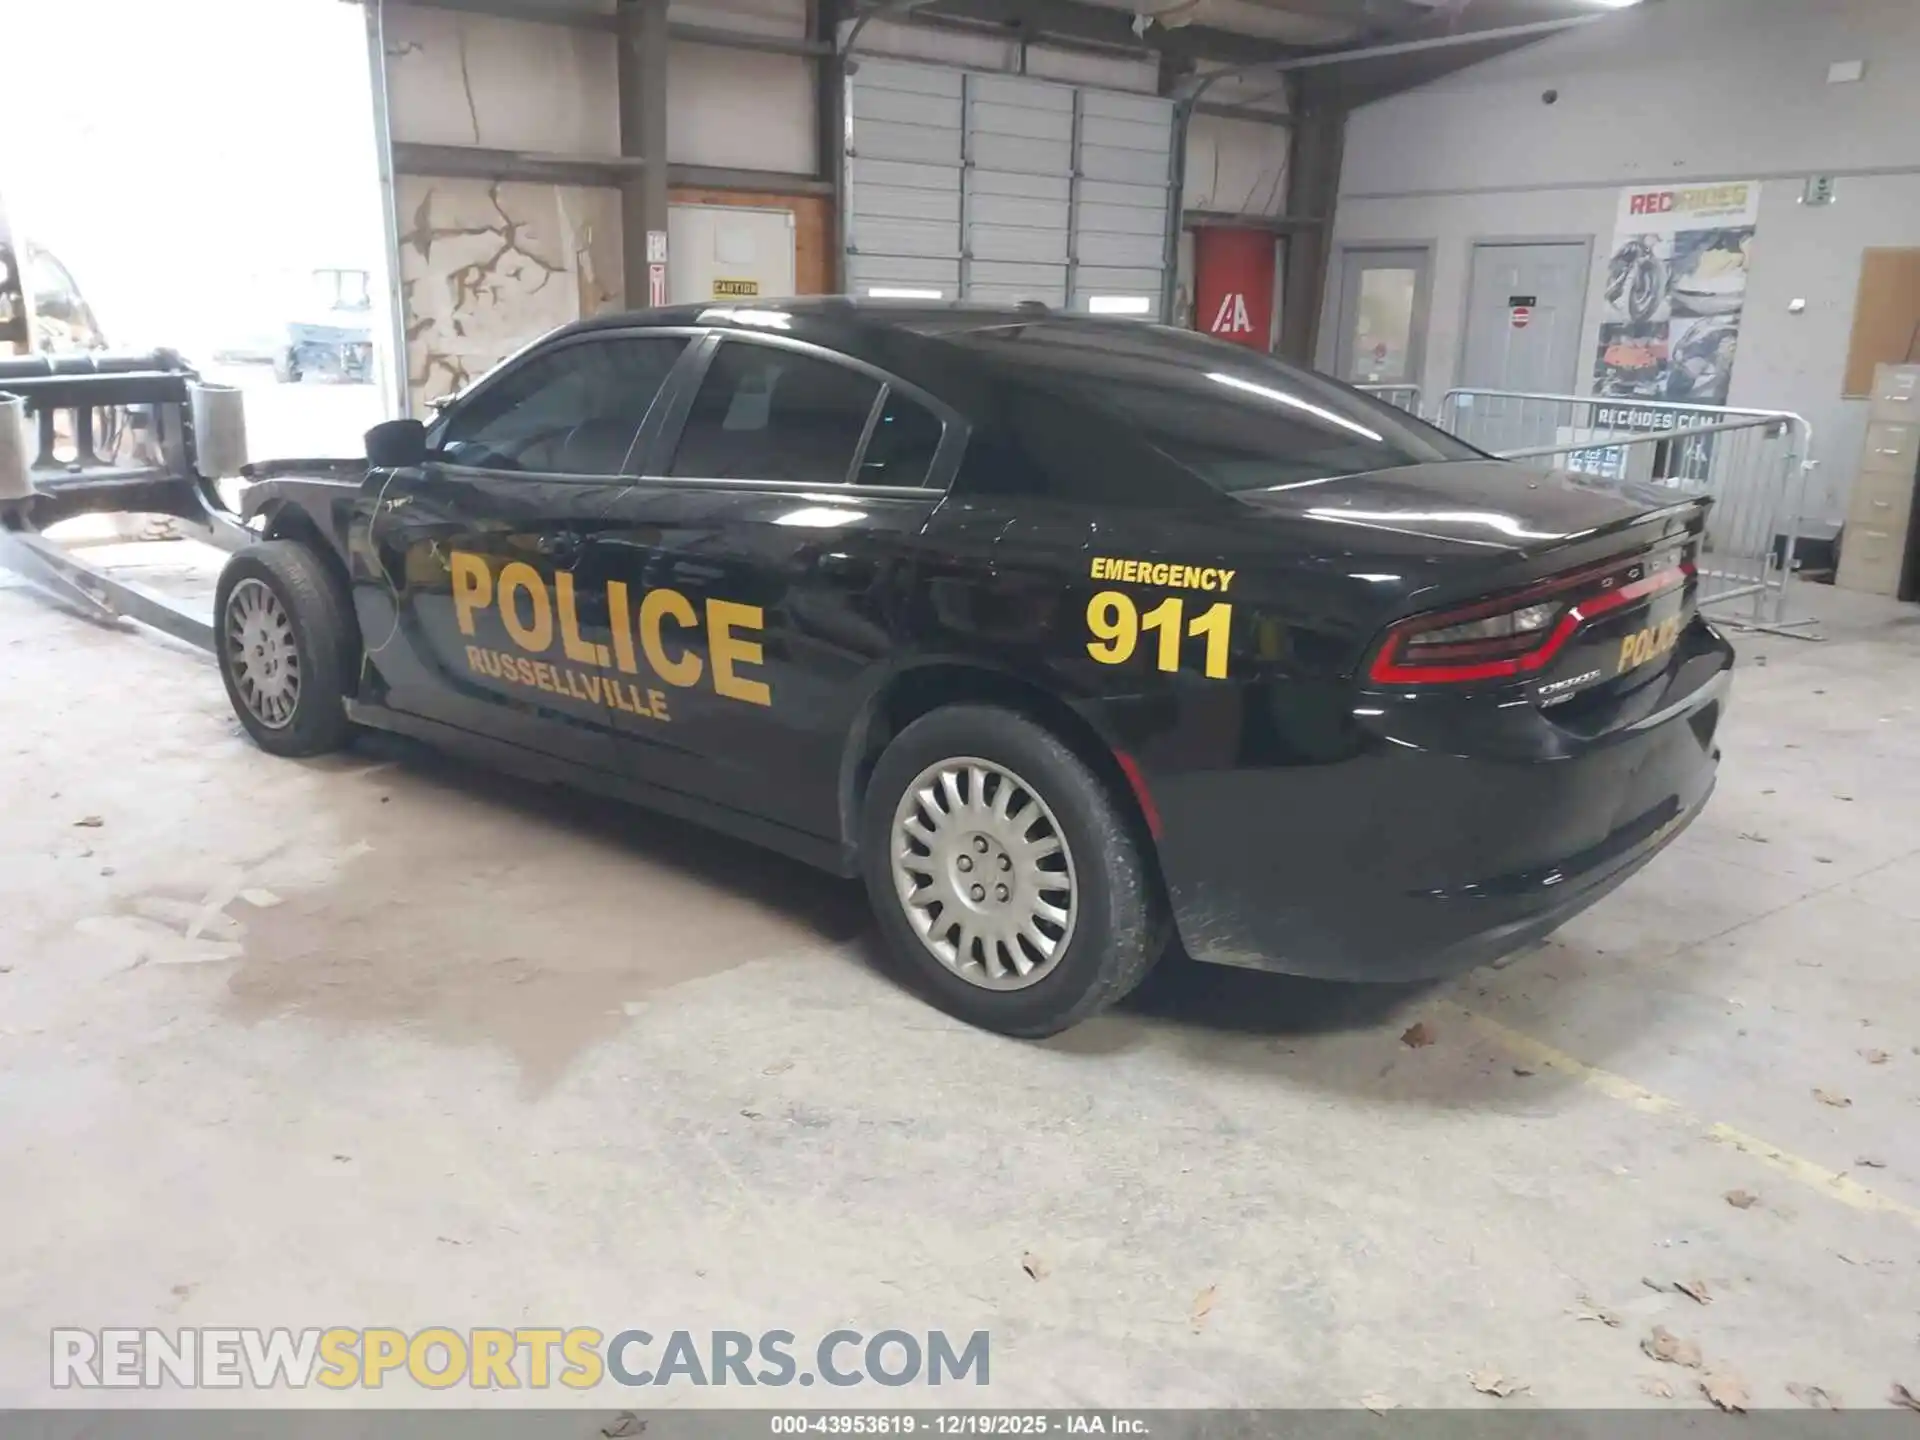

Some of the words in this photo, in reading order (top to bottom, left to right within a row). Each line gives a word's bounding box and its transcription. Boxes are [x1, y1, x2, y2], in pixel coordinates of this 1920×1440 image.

[1091, 557, 1236, 592] EMERGENCY
[451, 551, 772, 706] POLICE
[1086, 590, 1233, 680] 911
[465, 645, 672, 722] RUSSELLVILLE
